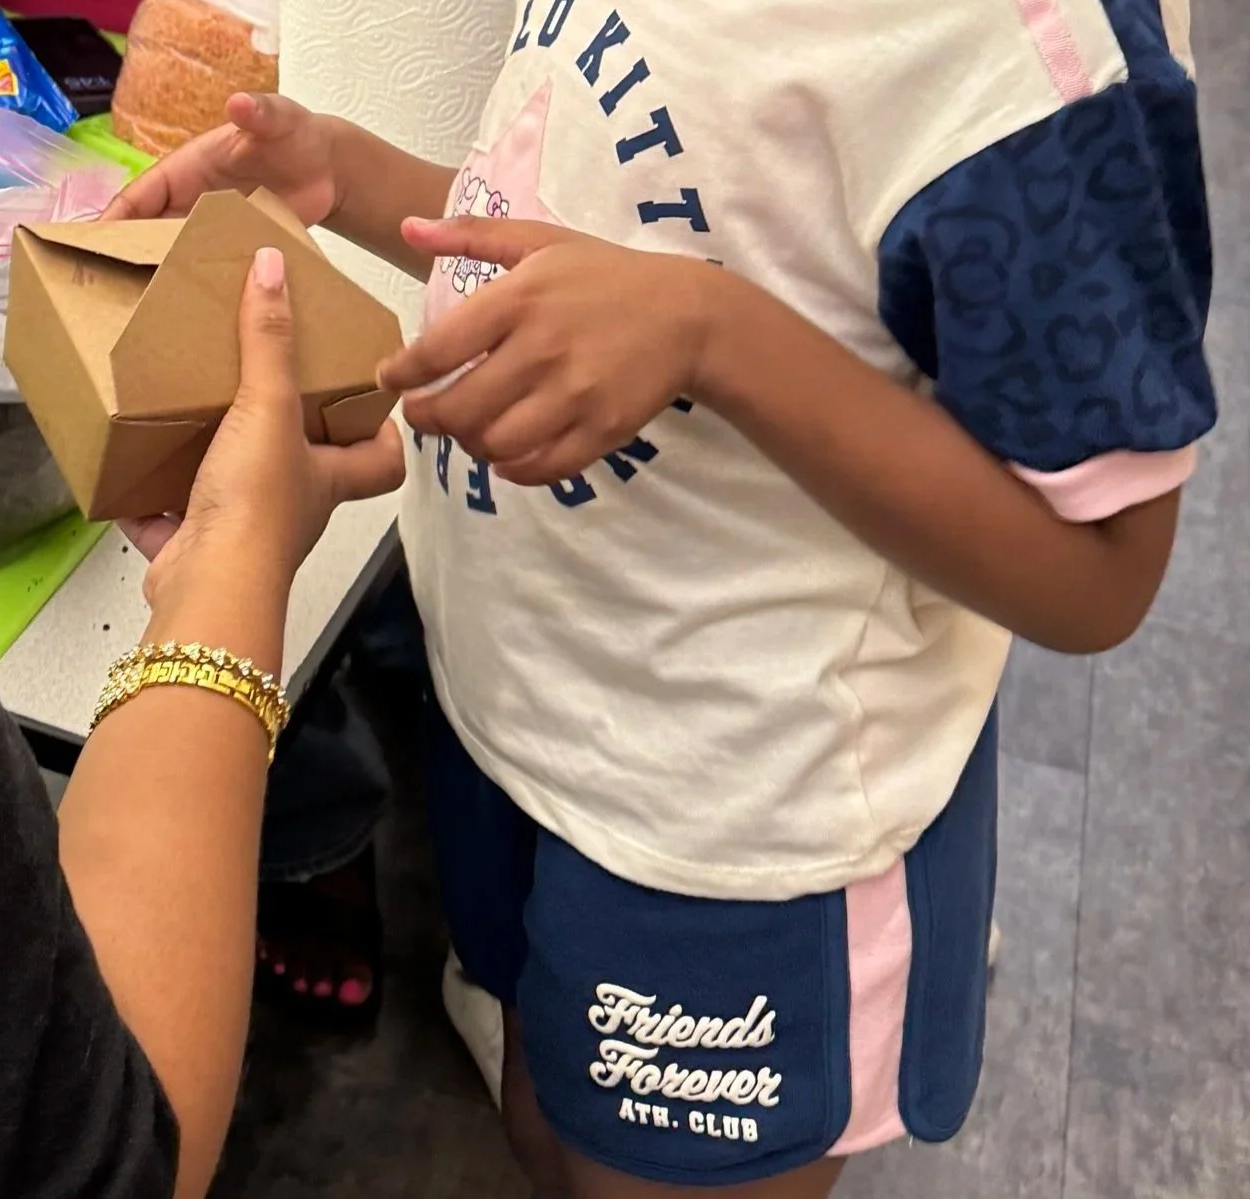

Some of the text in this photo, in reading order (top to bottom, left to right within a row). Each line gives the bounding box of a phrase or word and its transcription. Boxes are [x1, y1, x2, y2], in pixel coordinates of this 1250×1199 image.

[588, 982, 777, 1049] Friends
[589, 1039, 782, 1107] Forever
[618, 1097, 759, 1143] ATH. CLUB
